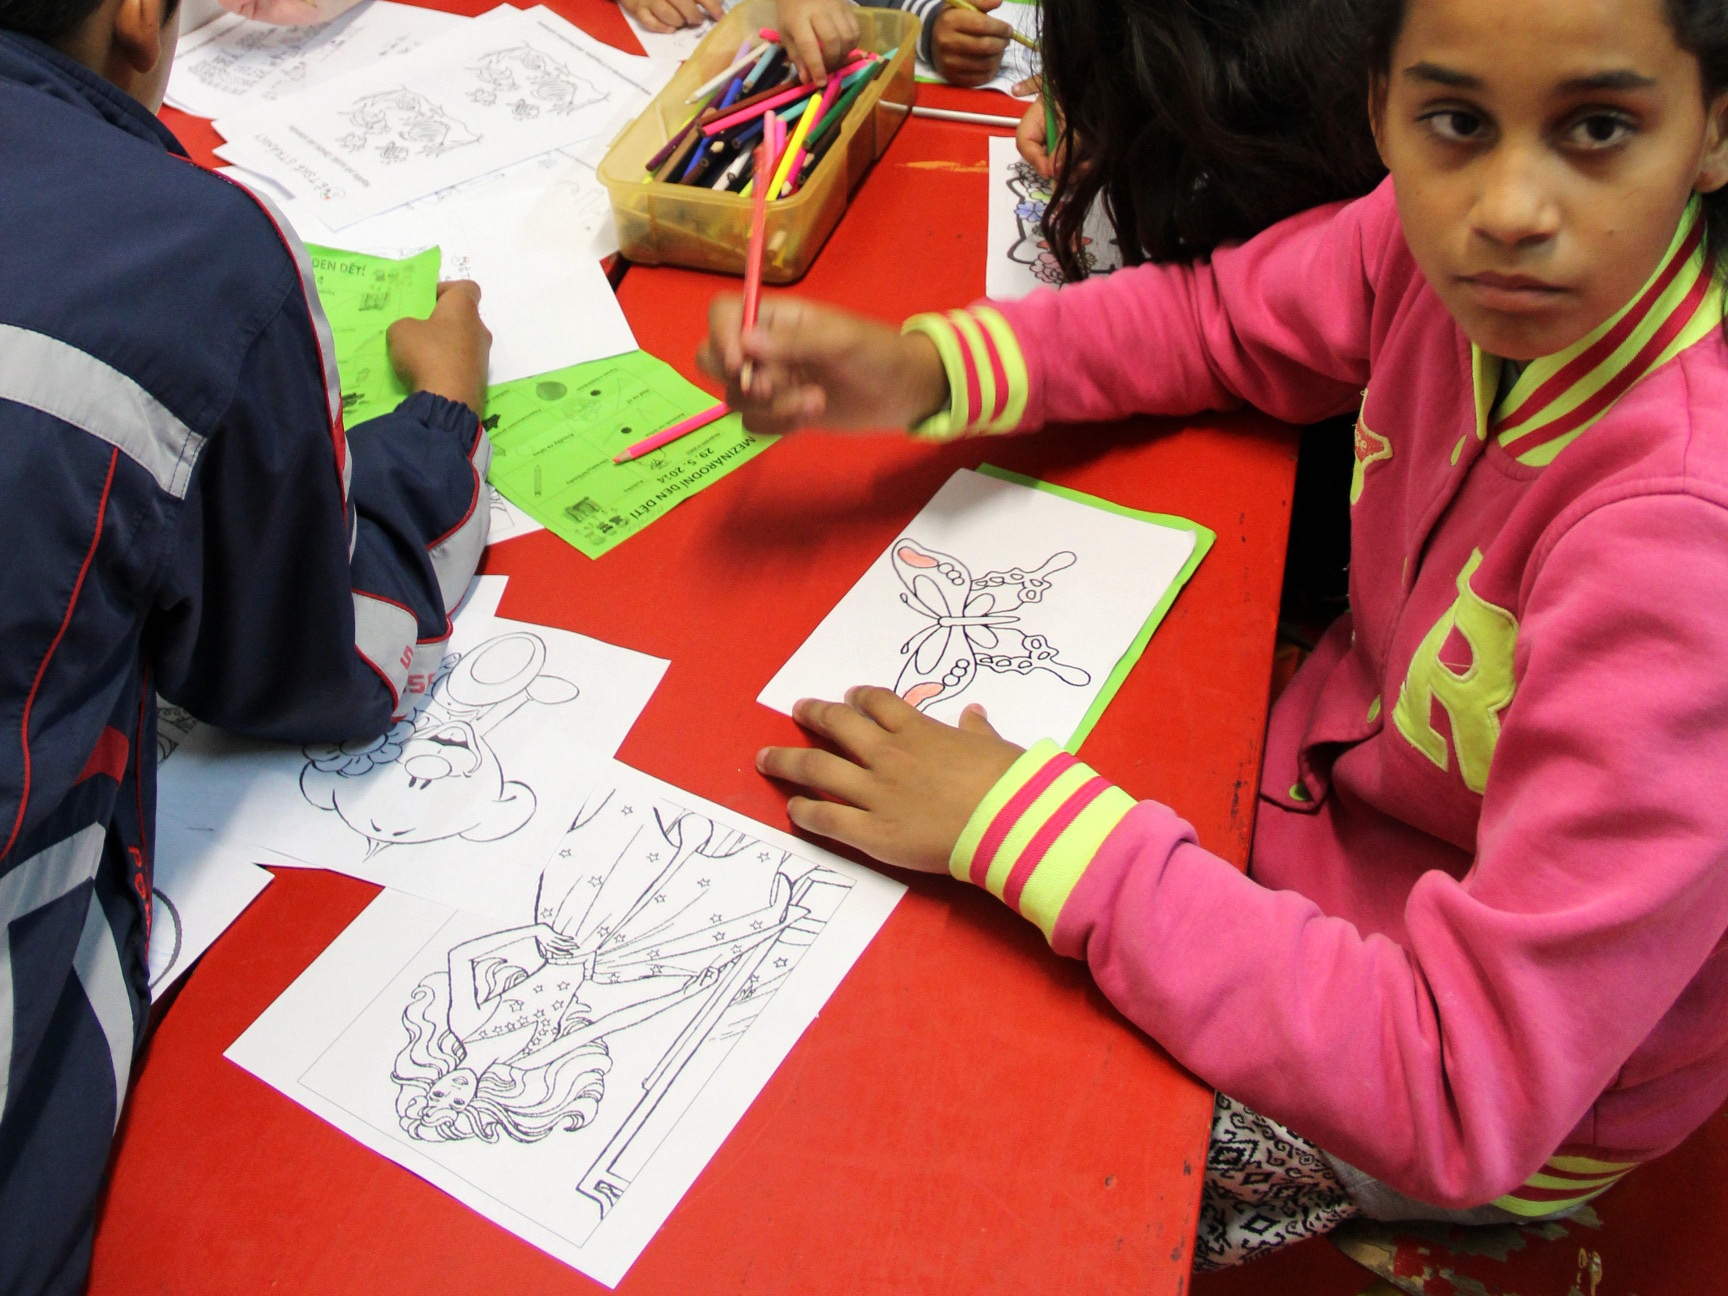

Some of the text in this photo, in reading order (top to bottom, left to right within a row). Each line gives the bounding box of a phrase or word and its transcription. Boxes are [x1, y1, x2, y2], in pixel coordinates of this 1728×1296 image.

[312, 257, 336, 271] DEN
[683, 436, 757, 489] MEZINÁRODNÍ
[656, 483, 682, 501] DEN
[630, 499, 657, 520] DĚTÍ
